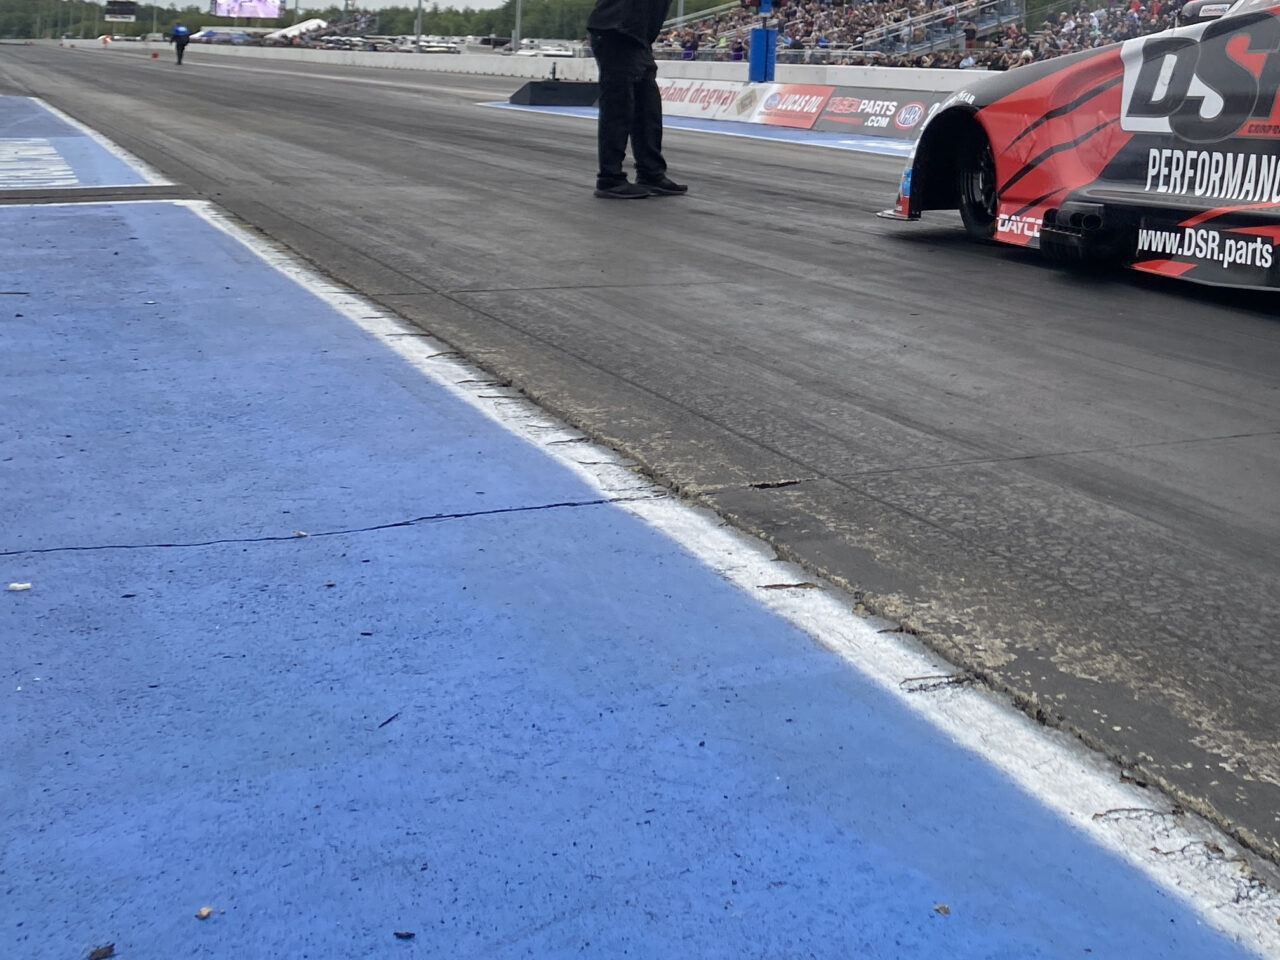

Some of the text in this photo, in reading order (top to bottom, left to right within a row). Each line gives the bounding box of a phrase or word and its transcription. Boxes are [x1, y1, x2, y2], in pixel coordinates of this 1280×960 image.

[687, 82, 740, 112] dragway
[776, 93, 807, 111] LUCAS
[803, 96, 824, 113] OIL
[858, 99, 898, 116] PARTS
[901, 105, 922, 126] NHRA
[864, 116, 890, 128] .COM
[1138, 227, 1273, 269] www.DSR.parts
